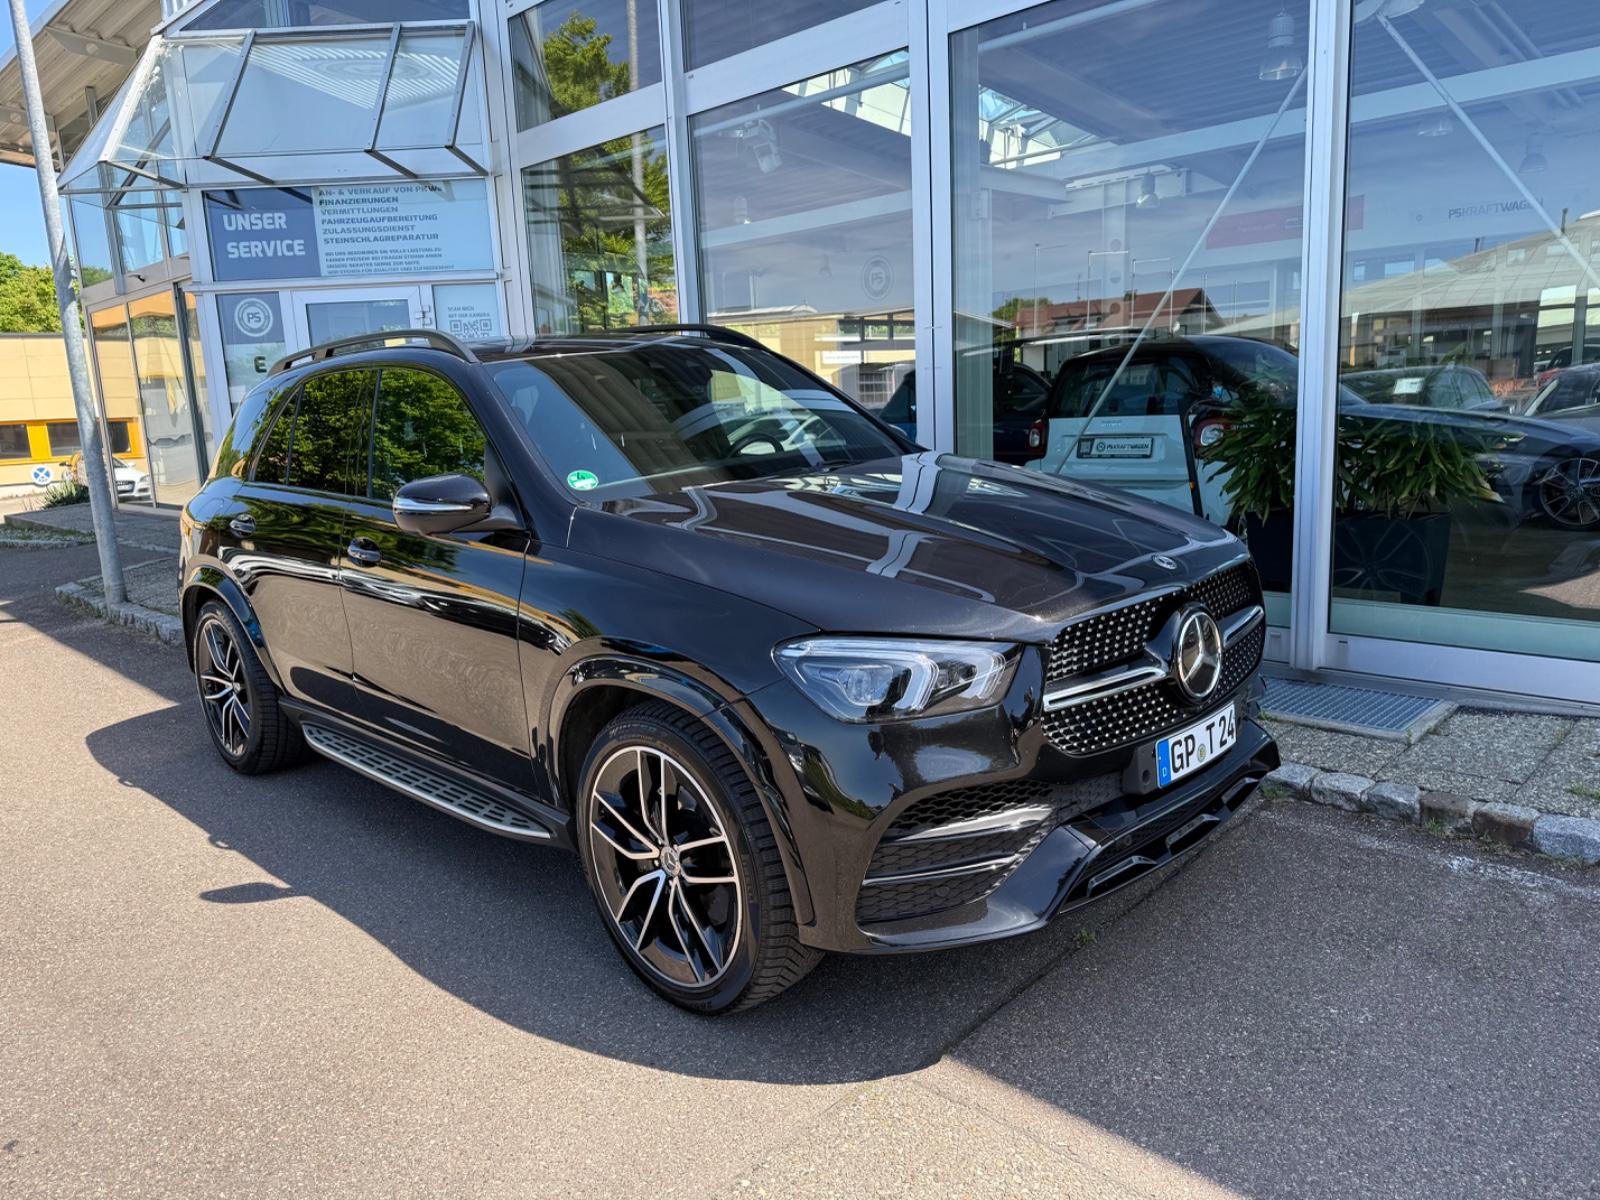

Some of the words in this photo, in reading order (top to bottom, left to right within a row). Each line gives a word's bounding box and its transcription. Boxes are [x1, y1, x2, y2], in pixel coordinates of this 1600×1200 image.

[347, 186, 391, 196] VERKAUF
[393, 185, 414, 194] VON
[319, 196, 399, 206] FINANZIERUNGEN
[320, 206, 398, 216] VERMITTLUNGEN
[222, 212, 288, 231] UNSER
[321, 214, 439, 225] FAHRZEUGAUFBEREITUNG
[322, 224, 416, 235] ZULASSUNGSDIENST
[323, 233, 439, 245] STEINSCHLAGREPARATUR
[226, 239, 306, 259] SERVICE
[246, 311, 262, 324] PS
[254, 355, 268, 373] E
[1170, 733, 1196, 773] GP
[1205, 721, 1216, 755] T
[1218, 709, 1236, 749] 24
